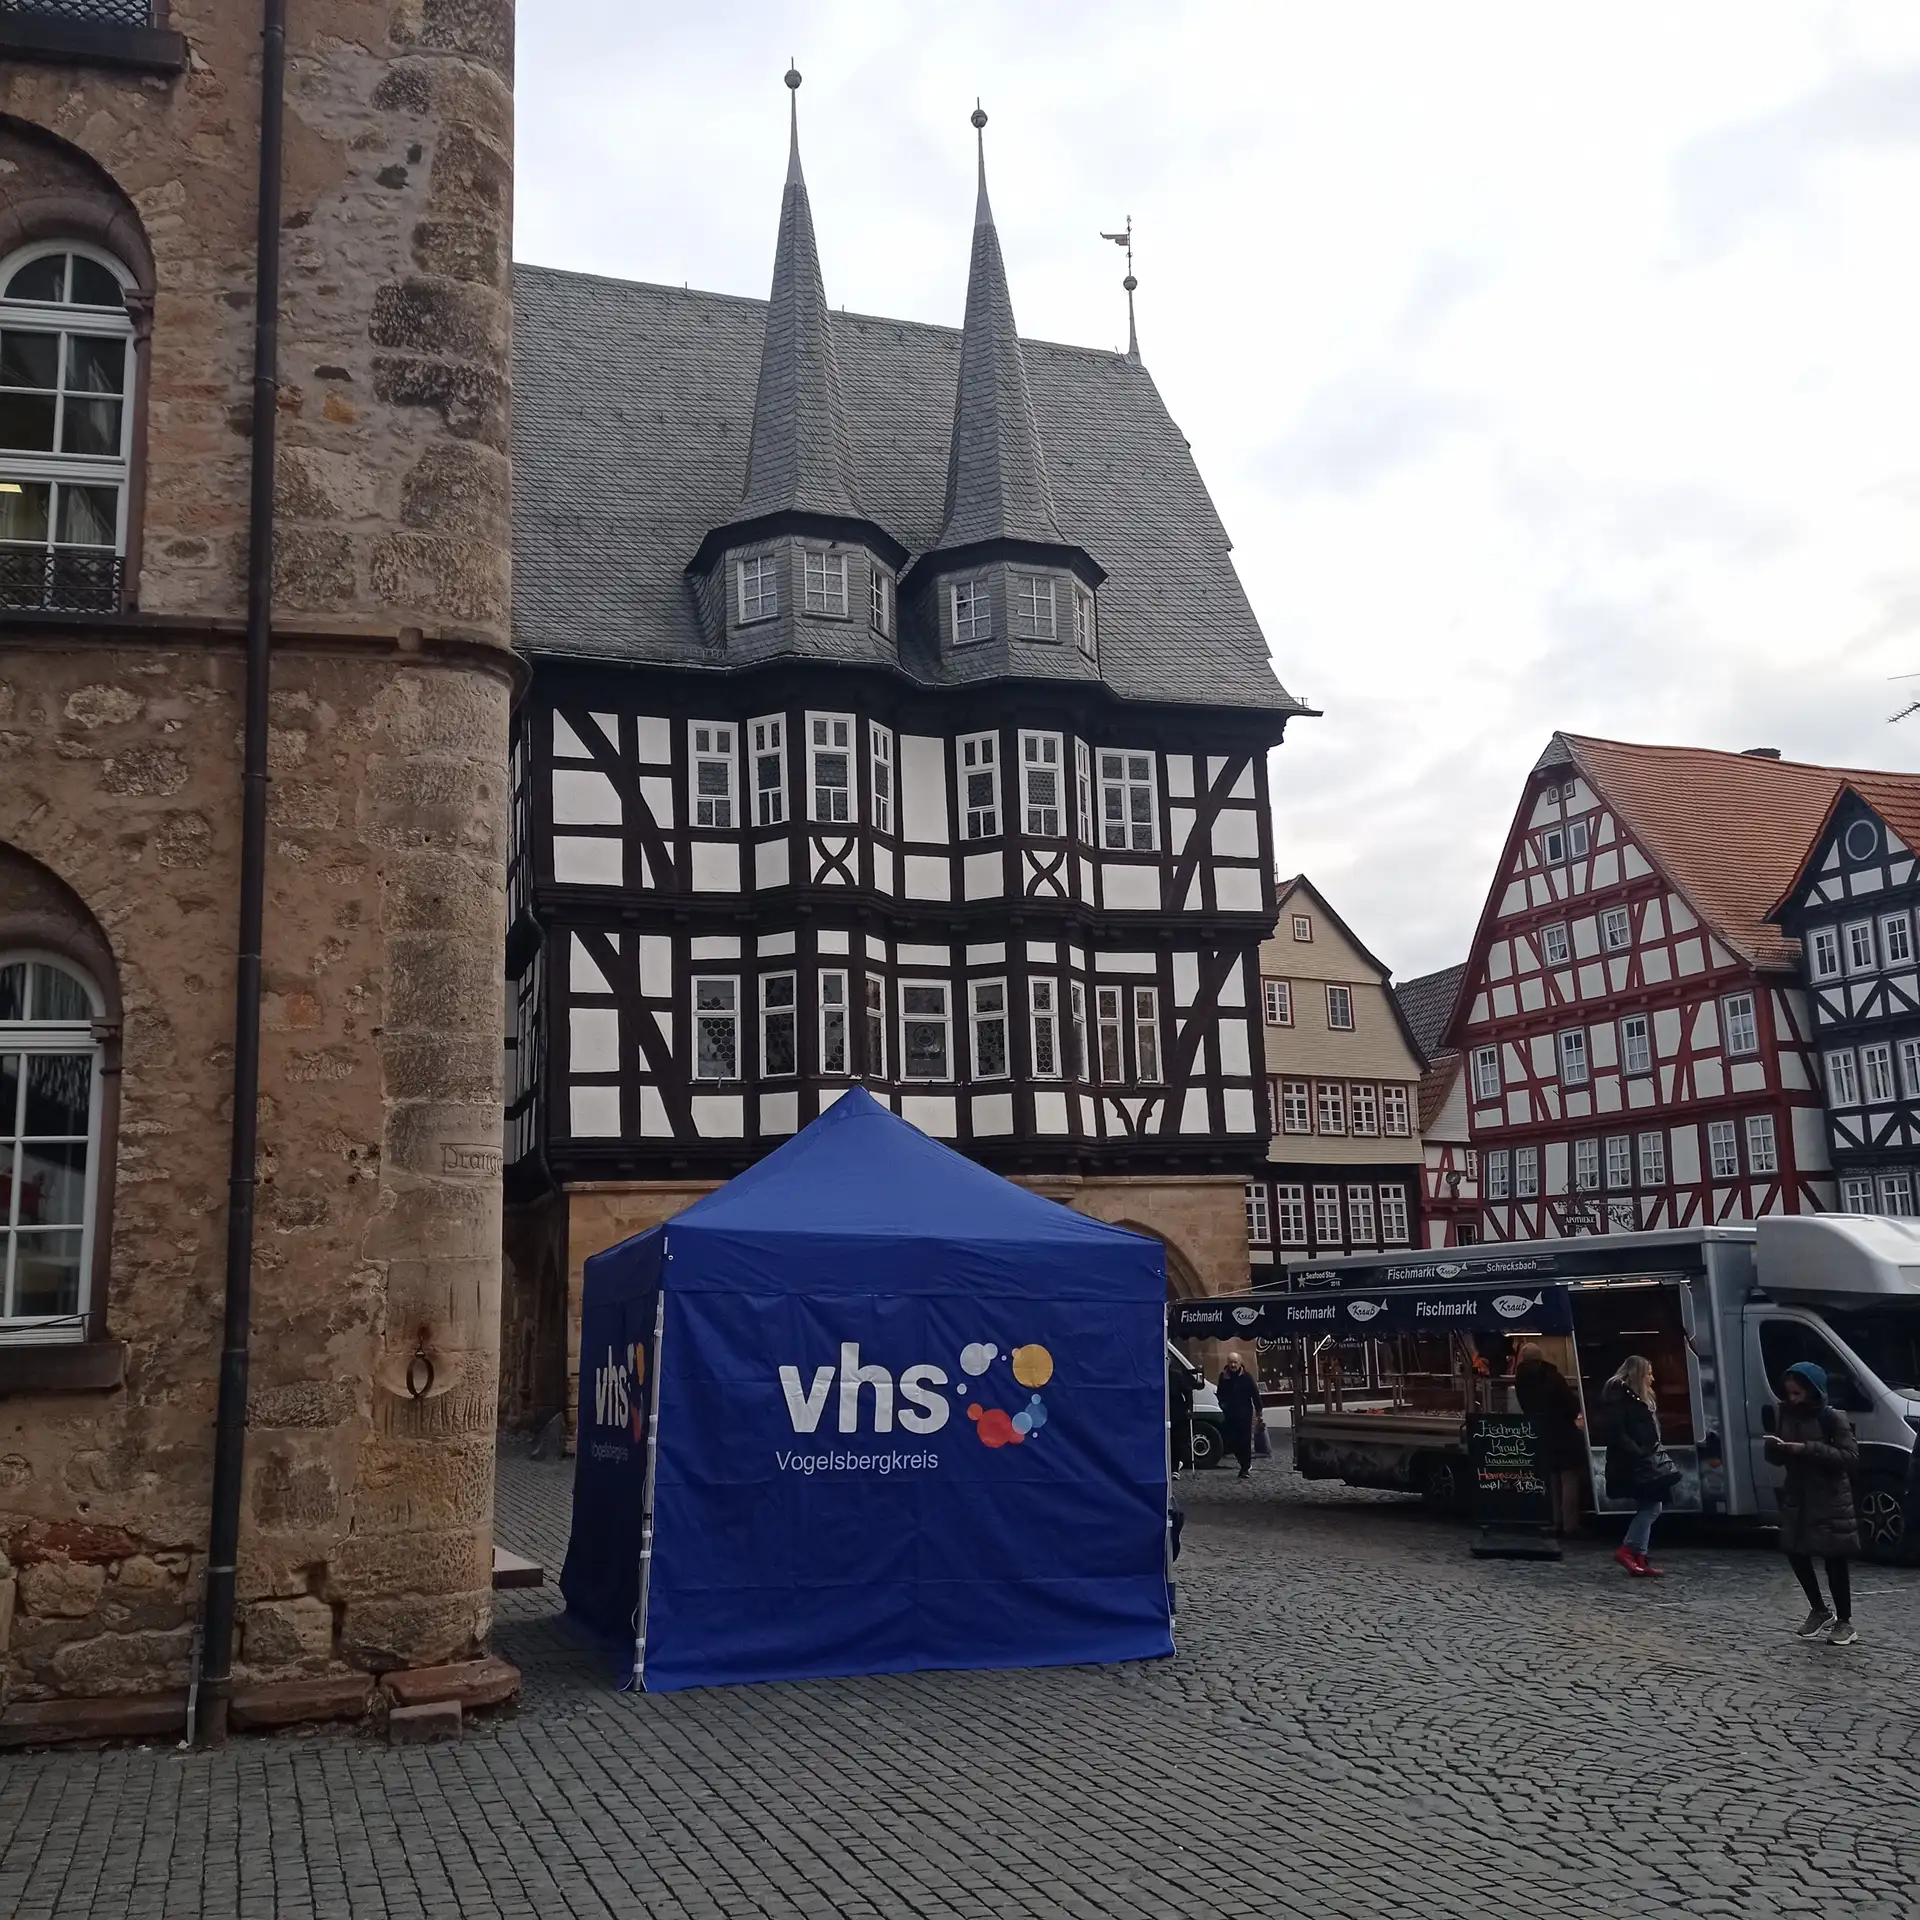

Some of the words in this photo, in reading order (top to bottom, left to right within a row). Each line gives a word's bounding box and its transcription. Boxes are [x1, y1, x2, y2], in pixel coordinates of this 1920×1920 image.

[1565, 1216, 1596, 1224] APOTHEKE
[1305, 1271, 1325, 1280] Seafood
[1325, 1270, 1336, 1279] Star
[1387, 1266, 1435, 1280] Fischmarkt
[1486, 1260, 1537, 1272] Schrecksbach
[1287, 1305, 1335, 1320] Fischmarkt
[1352, 1305, 1376, 1316] Krauß
[1416, 1300, 1477, 1317] Fischmarkt
[1499, 1299, 1528, 1312] Krauß
[1181, 1310, 1223, 1323] Fischmarkt
[596, 1345, 629, 1429] vhs
[778, 1342, 950, 1434] vhs
[1478, 1420, 1536, 1436] Fischmarkt
[1492, 1439, 1527, 1454] Krauß
[776, 1450, 939, 1475] Vogelsbergkreis
